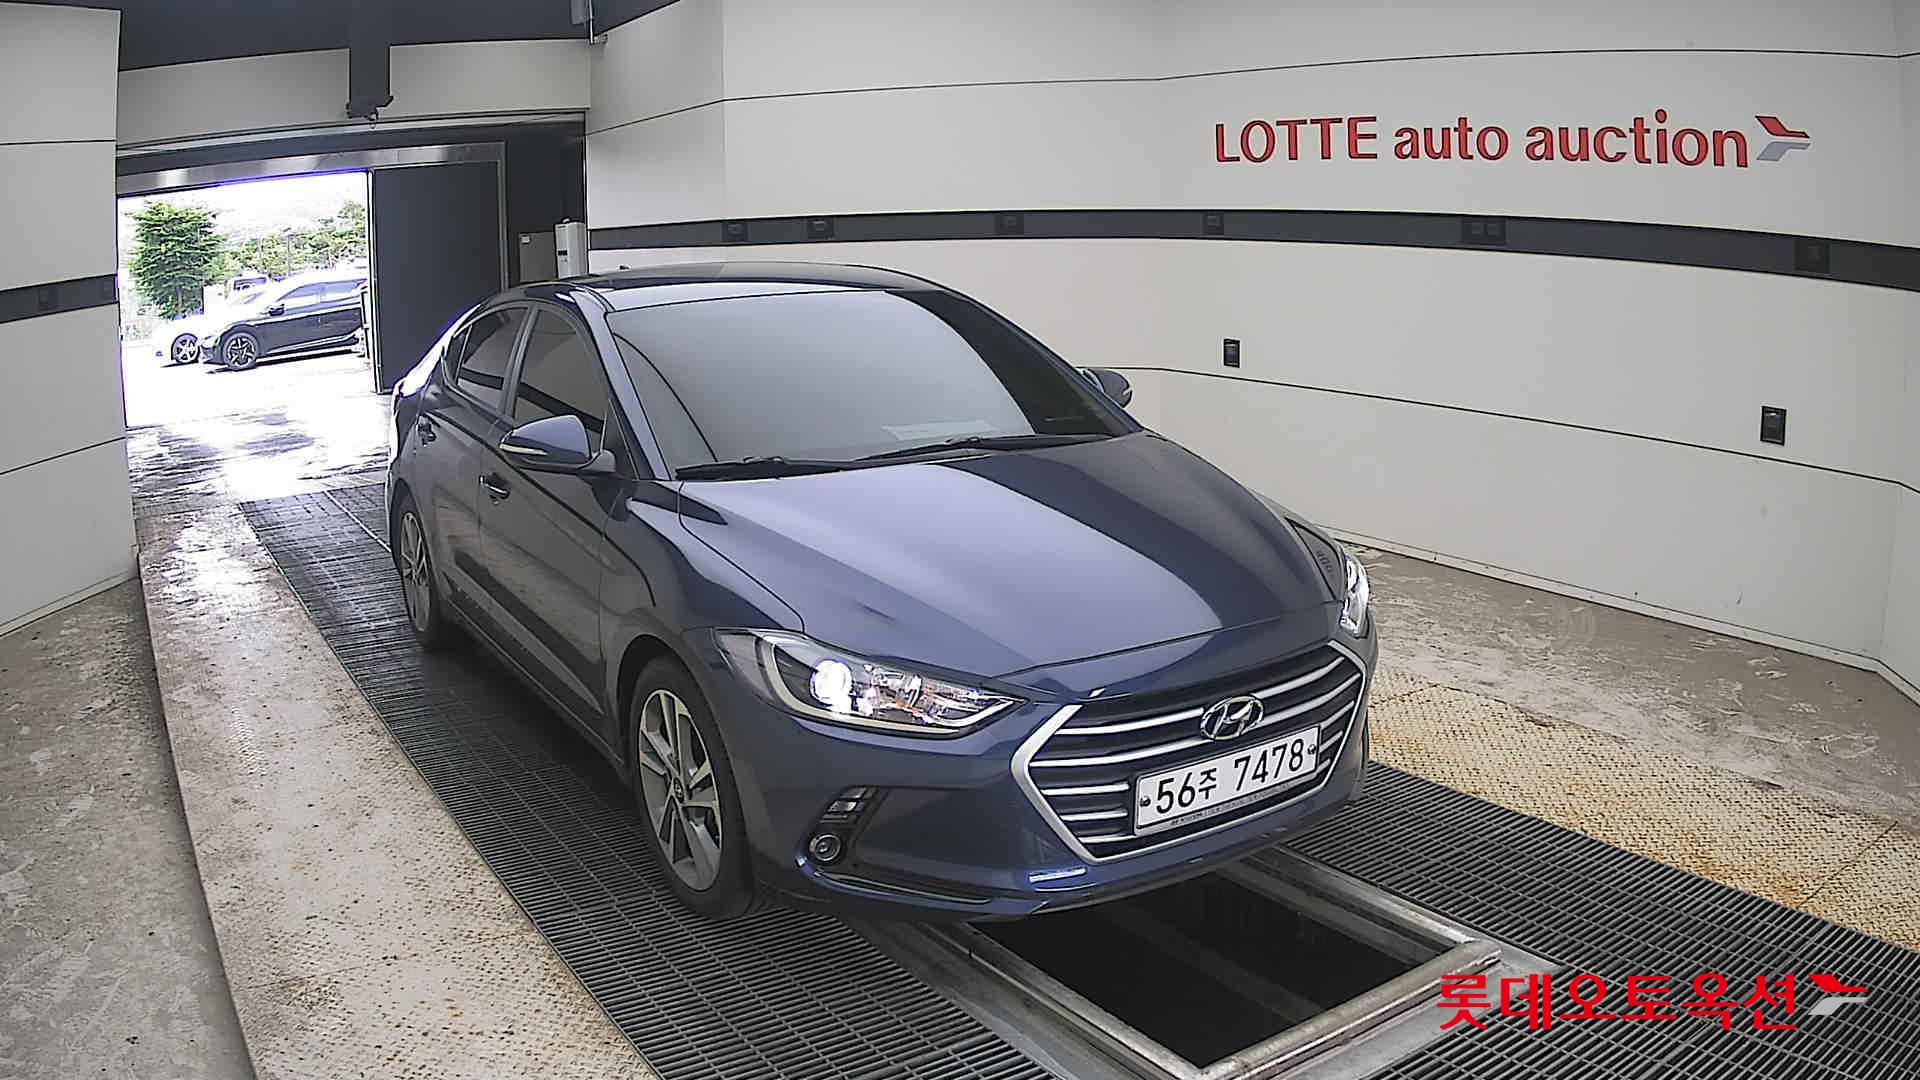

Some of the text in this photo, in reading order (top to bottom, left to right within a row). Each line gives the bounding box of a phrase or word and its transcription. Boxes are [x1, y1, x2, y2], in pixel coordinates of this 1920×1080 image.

[1214, 109, 1748, 168] LOTTE auto auction
[1155, 768, 1217, 814] 56주
[1234, 739, 1304, 791] 7478
